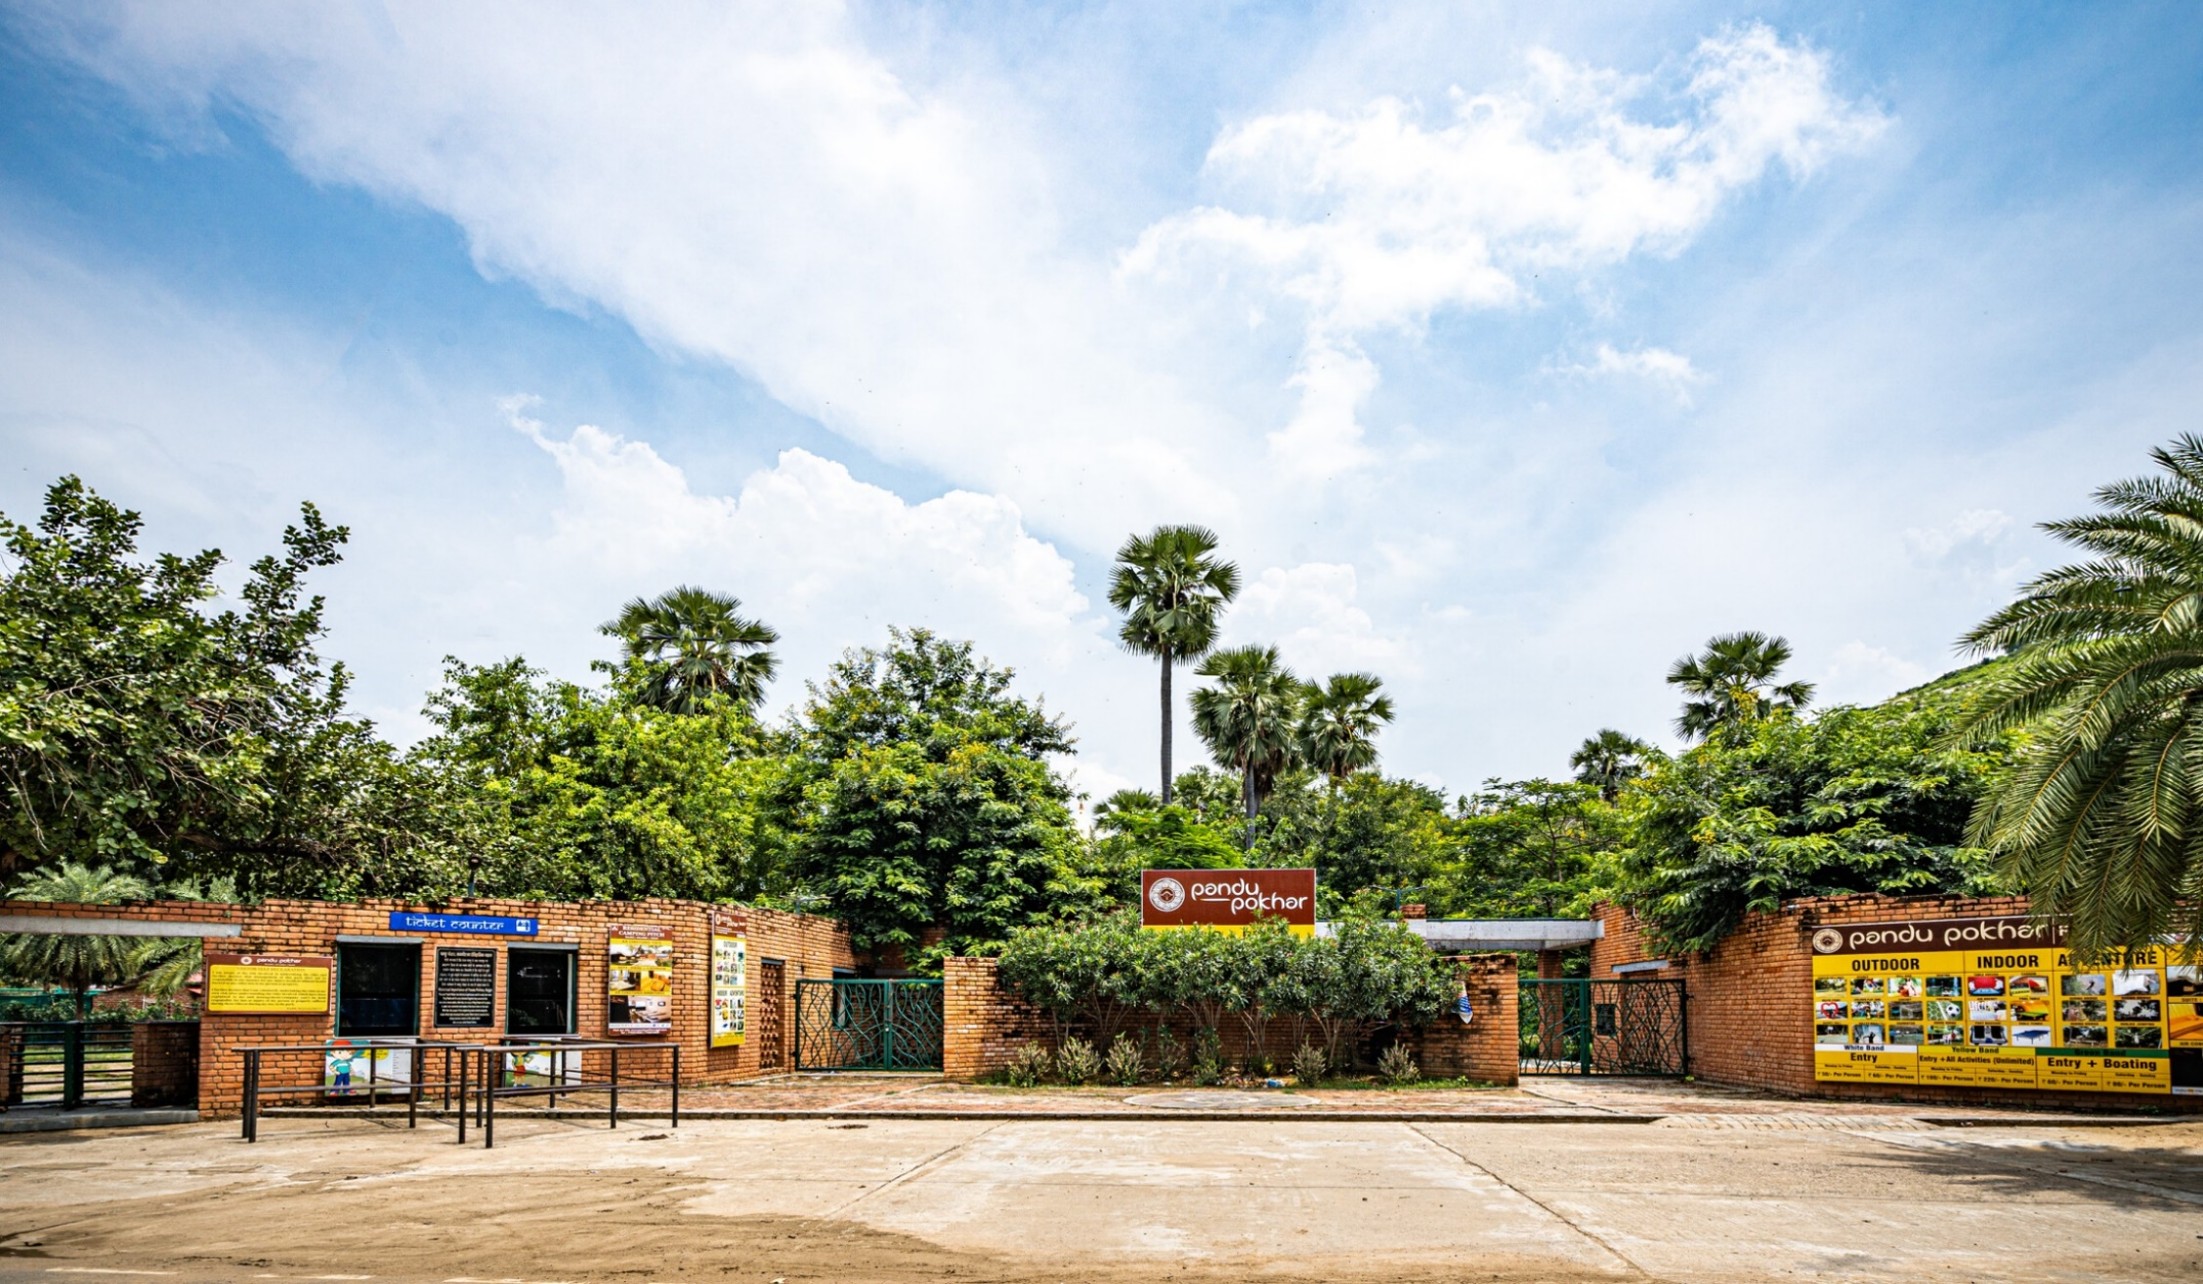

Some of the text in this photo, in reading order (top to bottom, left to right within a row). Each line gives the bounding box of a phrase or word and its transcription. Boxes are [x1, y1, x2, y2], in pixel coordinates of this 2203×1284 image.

[1190, 877, 1260, 901] pandu
[1230, 891, 1308, 915] pokhar
[405, 914, 504, 931] ticket counter
[1849, 922, 1934, 950] pandu
[1944, 920, 2049, 947] pokhar
[1851, 958, 1920, 972] OUTDOOR
[1977, 954, 2039, 969] INDOOR
[1866, 1044, 1885, 1052] Band
[1978, 1046, 2000, 1054] Band
[1850, 1052, 1878, 1063] Entry
[1919, 1055, 1938, 1063] Entry
[1957, 1056, 1991, 1064] Activities
[1993, 1057, 2035, 1066] (Unlimited)
[2047, 1057, 2081, 1069] Entry
[2103, 1058, 2157, 1071] Boating
